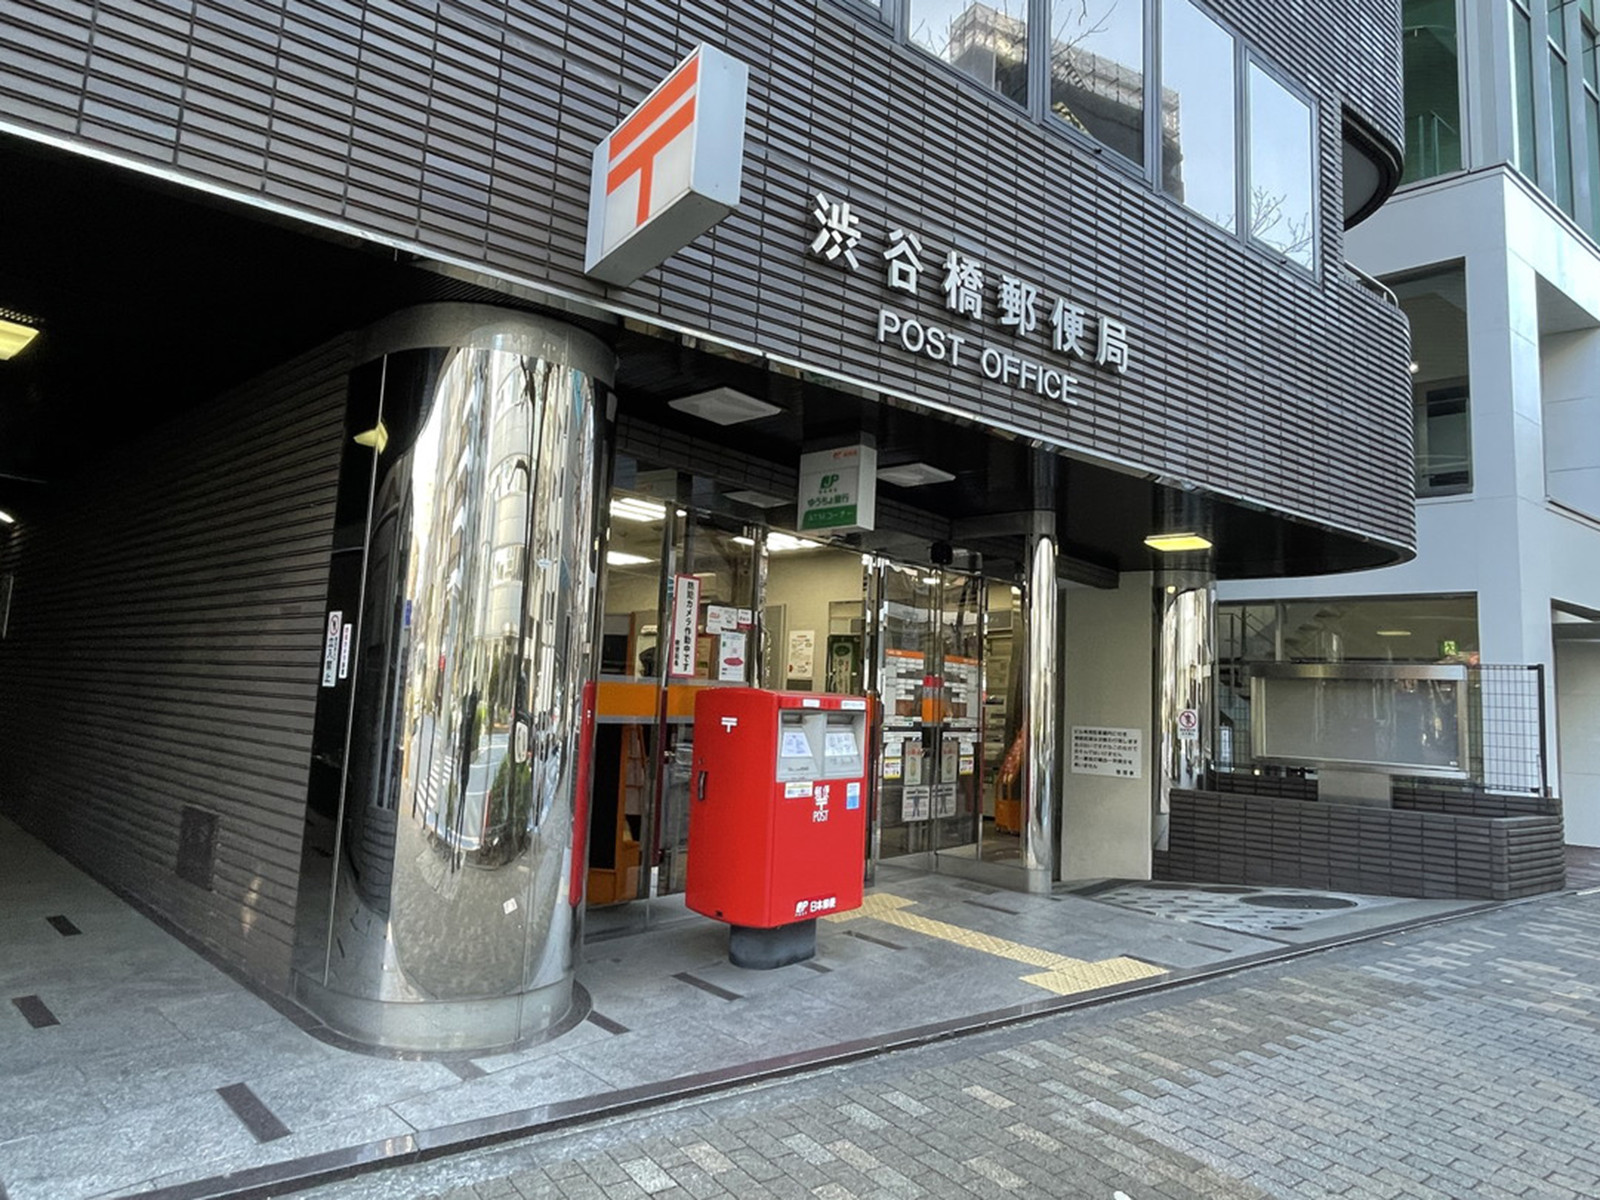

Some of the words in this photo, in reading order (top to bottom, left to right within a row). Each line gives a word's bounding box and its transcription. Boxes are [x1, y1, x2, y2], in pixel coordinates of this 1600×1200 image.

[809, 192, 1129, 375] 渋谷橋郵便局
[876, 309, 965, 367] POST
[980, 347, 1079, 407] OFFICE
[812, 810, 829, 823] POST
